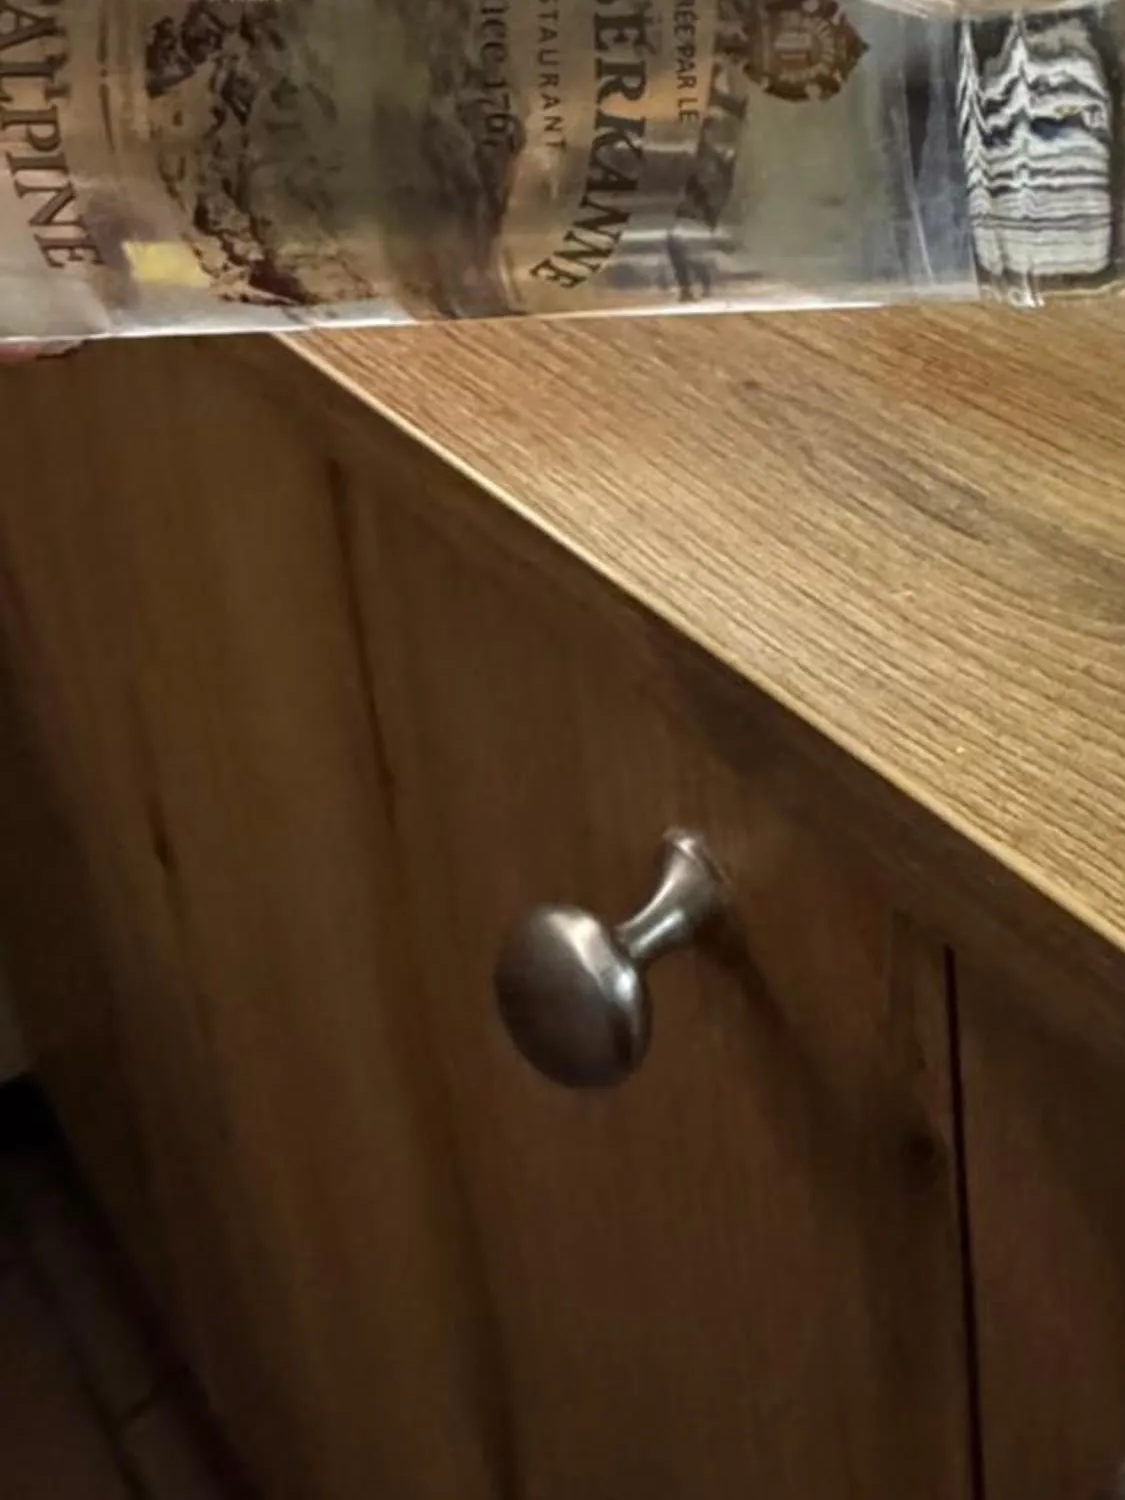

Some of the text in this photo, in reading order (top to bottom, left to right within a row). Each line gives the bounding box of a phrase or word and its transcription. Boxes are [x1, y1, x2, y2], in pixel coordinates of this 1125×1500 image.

[675, 45, 697, 90] PAR
[0, 0, 104, 268] ALPINE
[477, 78, 517, 152] 1767
[677, 98, 699, 124] LE
